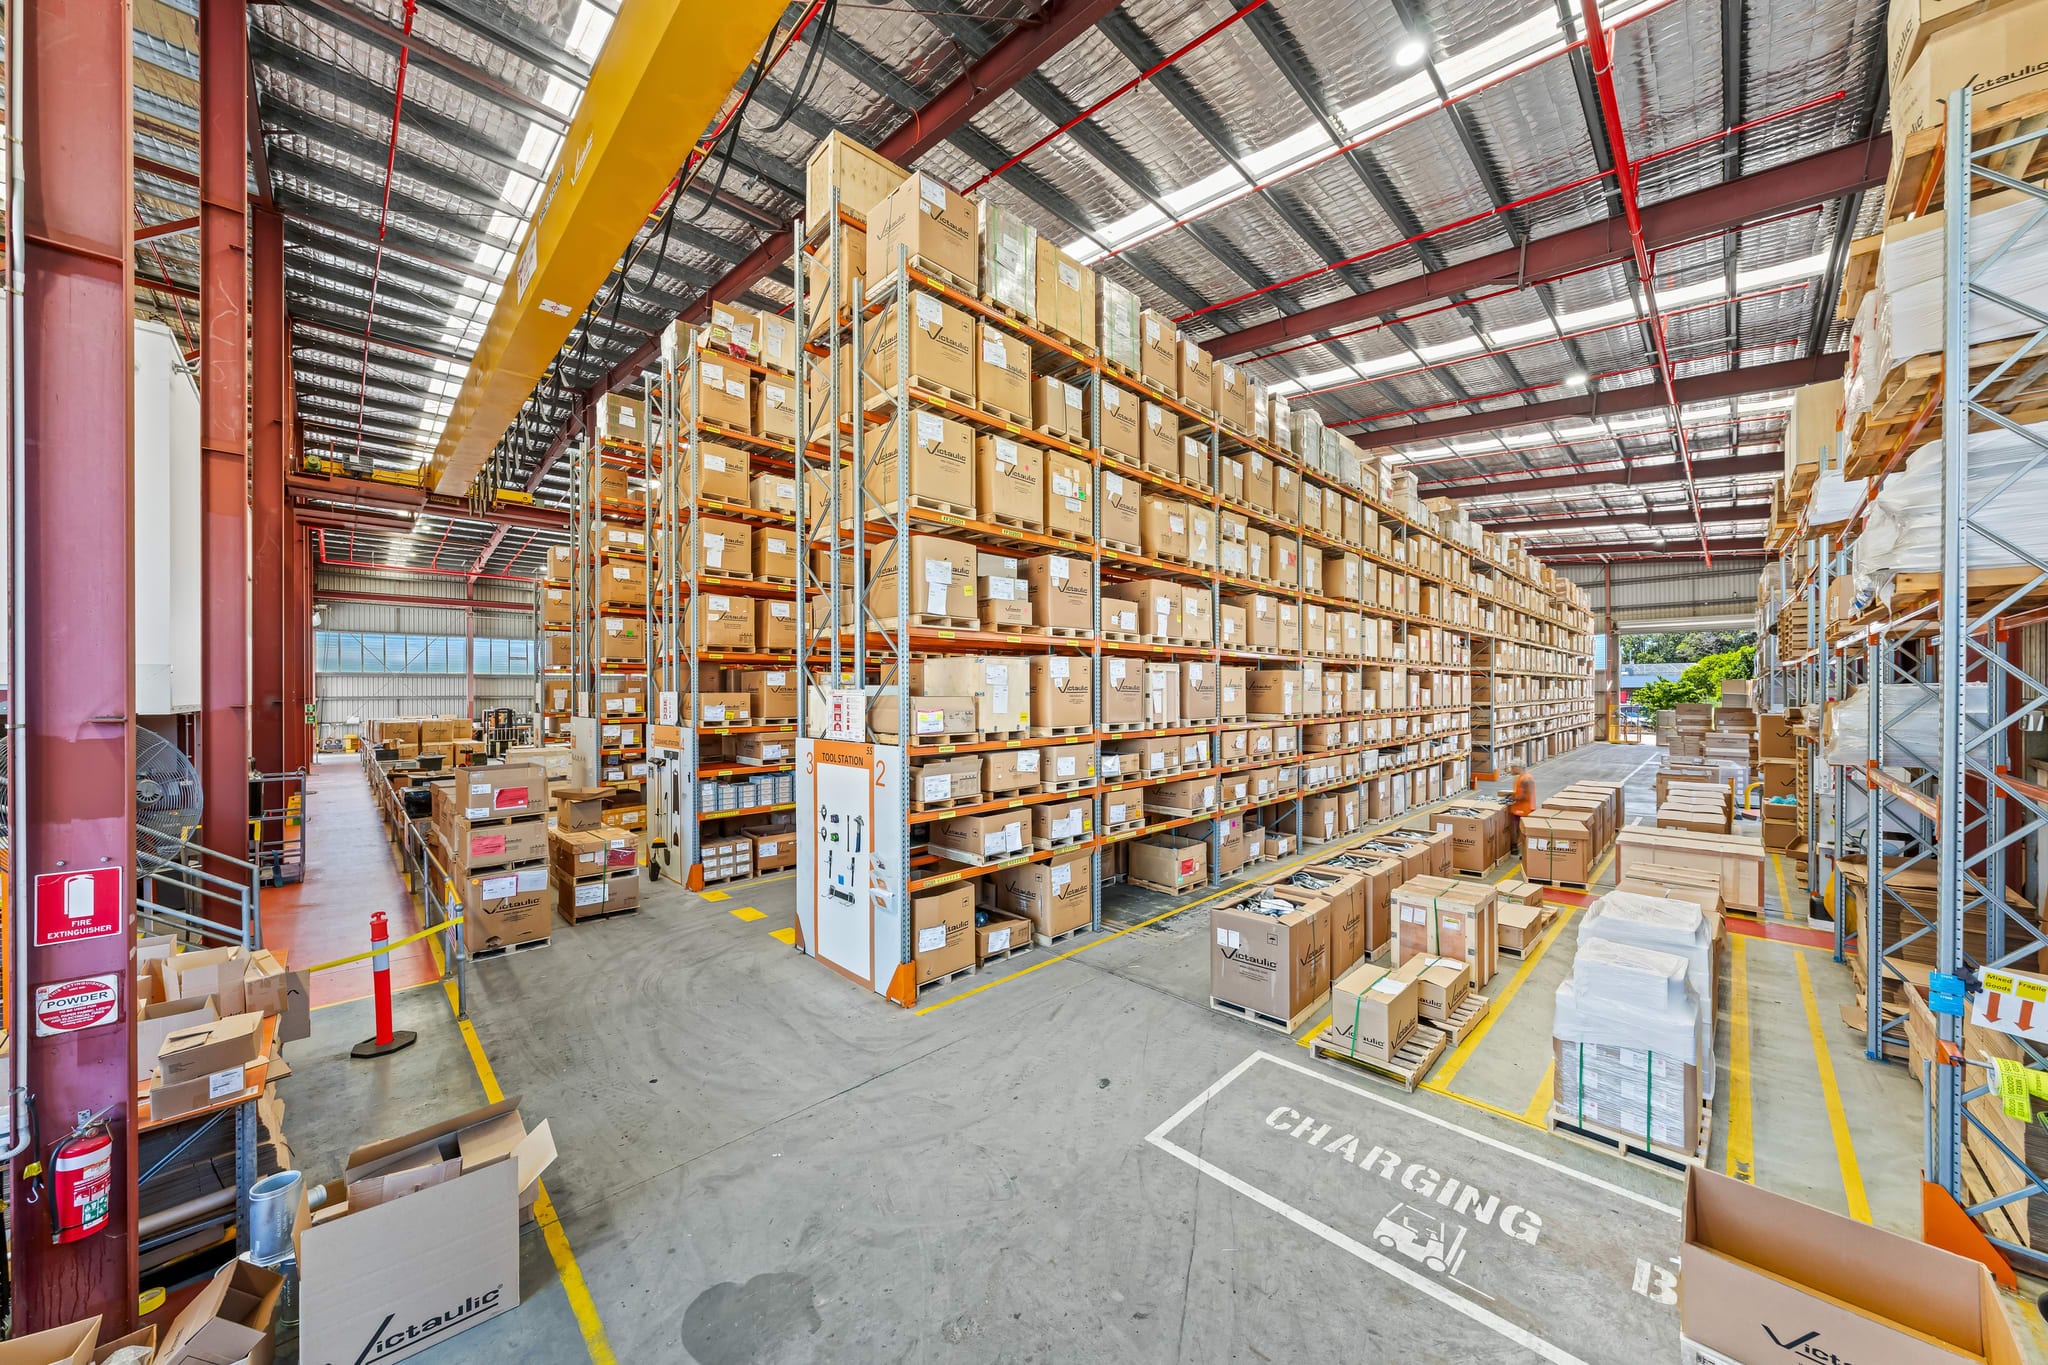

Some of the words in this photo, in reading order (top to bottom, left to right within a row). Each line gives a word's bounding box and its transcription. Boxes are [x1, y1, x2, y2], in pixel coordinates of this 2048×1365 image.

[927, 327, 969, 354] Victaulic
[926, 442, 967, 465] Victaulic
[1004, 465, 1037, 485] Victaulic
[1058, 679, 1088, 693] Victaulic
[822, 752, 836, 762] TOOL
[837, 754, 864, 766] STATION
[866, 746, 873, 755] 5S
[806, 751, 814, 775] 3
[875, 760, 886, 787] 2
[1058, 884, 1088, 900] Victaulic
[482, 898, 541, 915] Victaulic
[71, 919, 92, 927] FIRE
[47, 924, 112, 940] EXTINGUISHER
[1221, 944, 1277, 971] Victaulic
[1985, 981, 2012, 993] Goods
[1987, 973, 2013, 984] Mixed
[2018, 981, 2047, 993] Fragile
[47, 991, 108, 1009] POWDER
[1265, 1106, 1544, 1246] CHARGING
[326, 1286, 499, 1365] Victaulic
